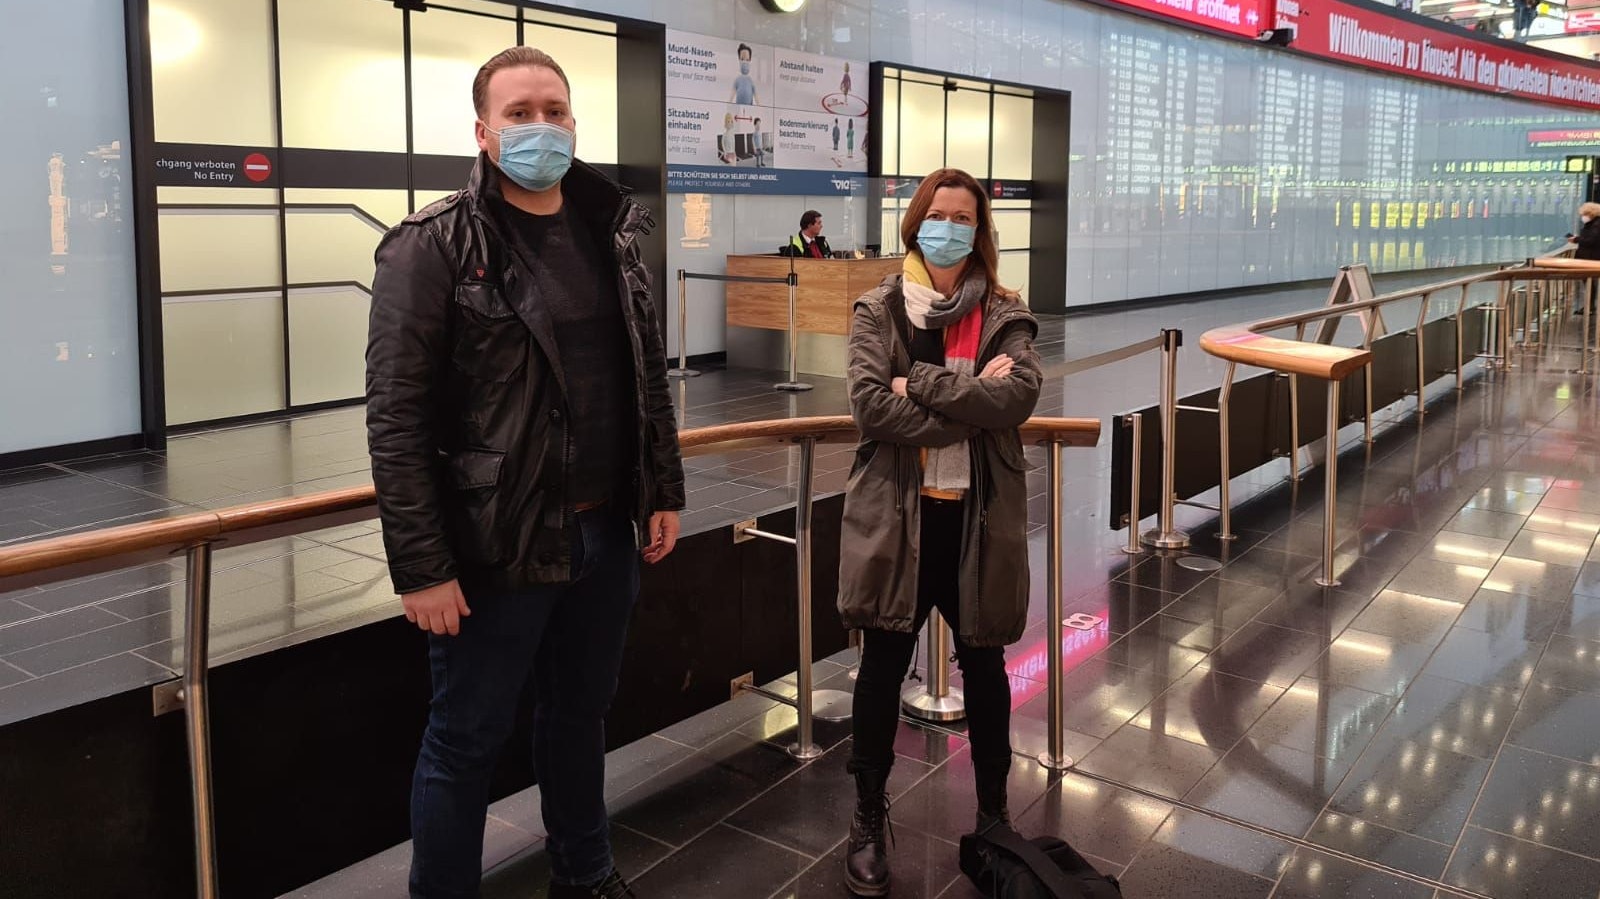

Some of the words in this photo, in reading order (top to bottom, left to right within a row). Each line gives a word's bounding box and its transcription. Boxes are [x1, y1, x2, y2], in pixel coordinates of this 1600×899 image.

[668, 43, 716, 58] Mund-Nasen-
[1329, 12, 1406, 67] Willkommen
[1406, 41, 1420, 70] zu
[1421, 38, 1460, 78] Hause!
[1459, 47, 1477, 82] Mit
[1477, 52, 1497, 86] den
[1497, 58, 1550, 95] aktuellsten
[668, 55, 693, 67] Schutz
[694, 59, 718, 71] tragen
[780, 60, 805, 71] Abstand
[805, 63, 824, 74] halten
[668, 108, 710, 120] Sitzabstand
[668, 119, 702, 131] einhalten
[779, 119, 829, 132] Bodenmarkierung
[779, 129, 807, 139] beachten
[156, 158, 192, 170] chgang
[194, 160, 236, 170] verboten
[194, 171, 208, 180] No
[209, 171, 235, 182] Entry
